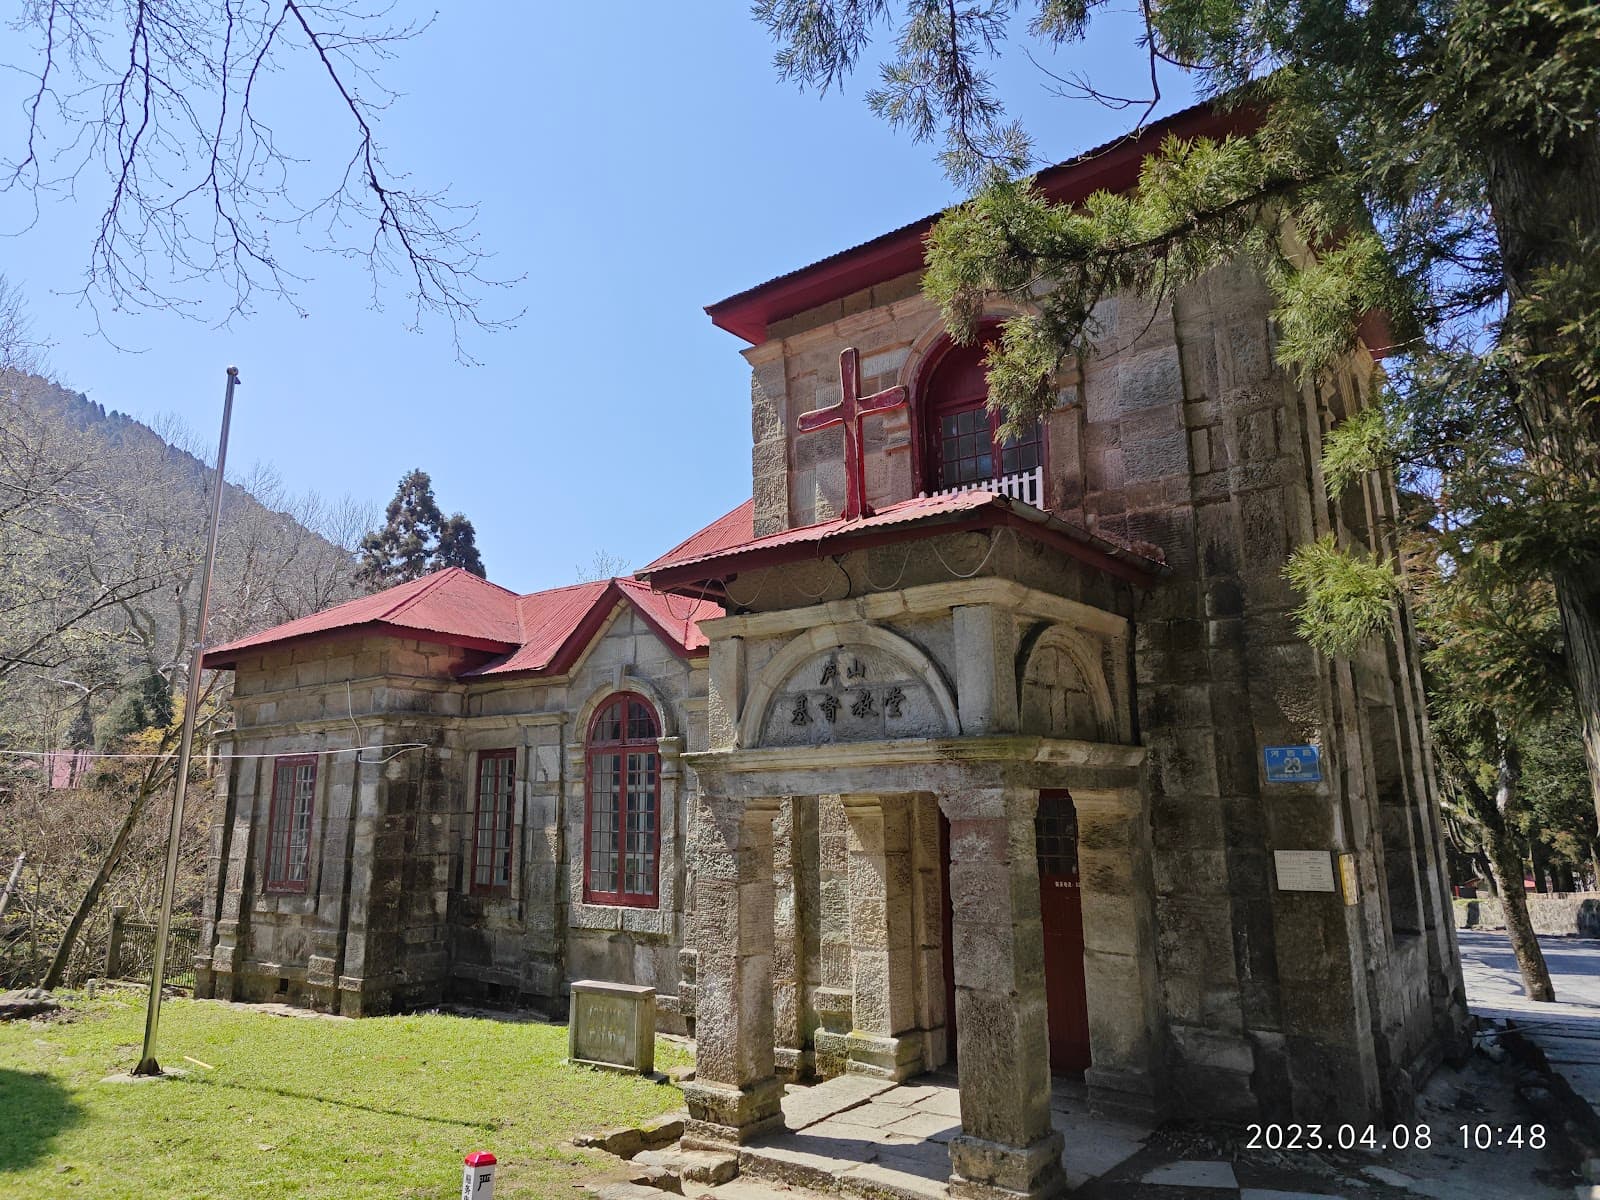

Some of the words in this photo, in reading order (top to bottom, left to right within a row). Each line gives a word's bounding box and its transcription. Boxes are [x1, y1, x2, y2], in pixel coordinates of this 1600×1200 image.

[820, 659, 866, 685] 庐山
[791, 687, 906, 726] 基督教堂
[1284, 757, 1302, 773] 23
